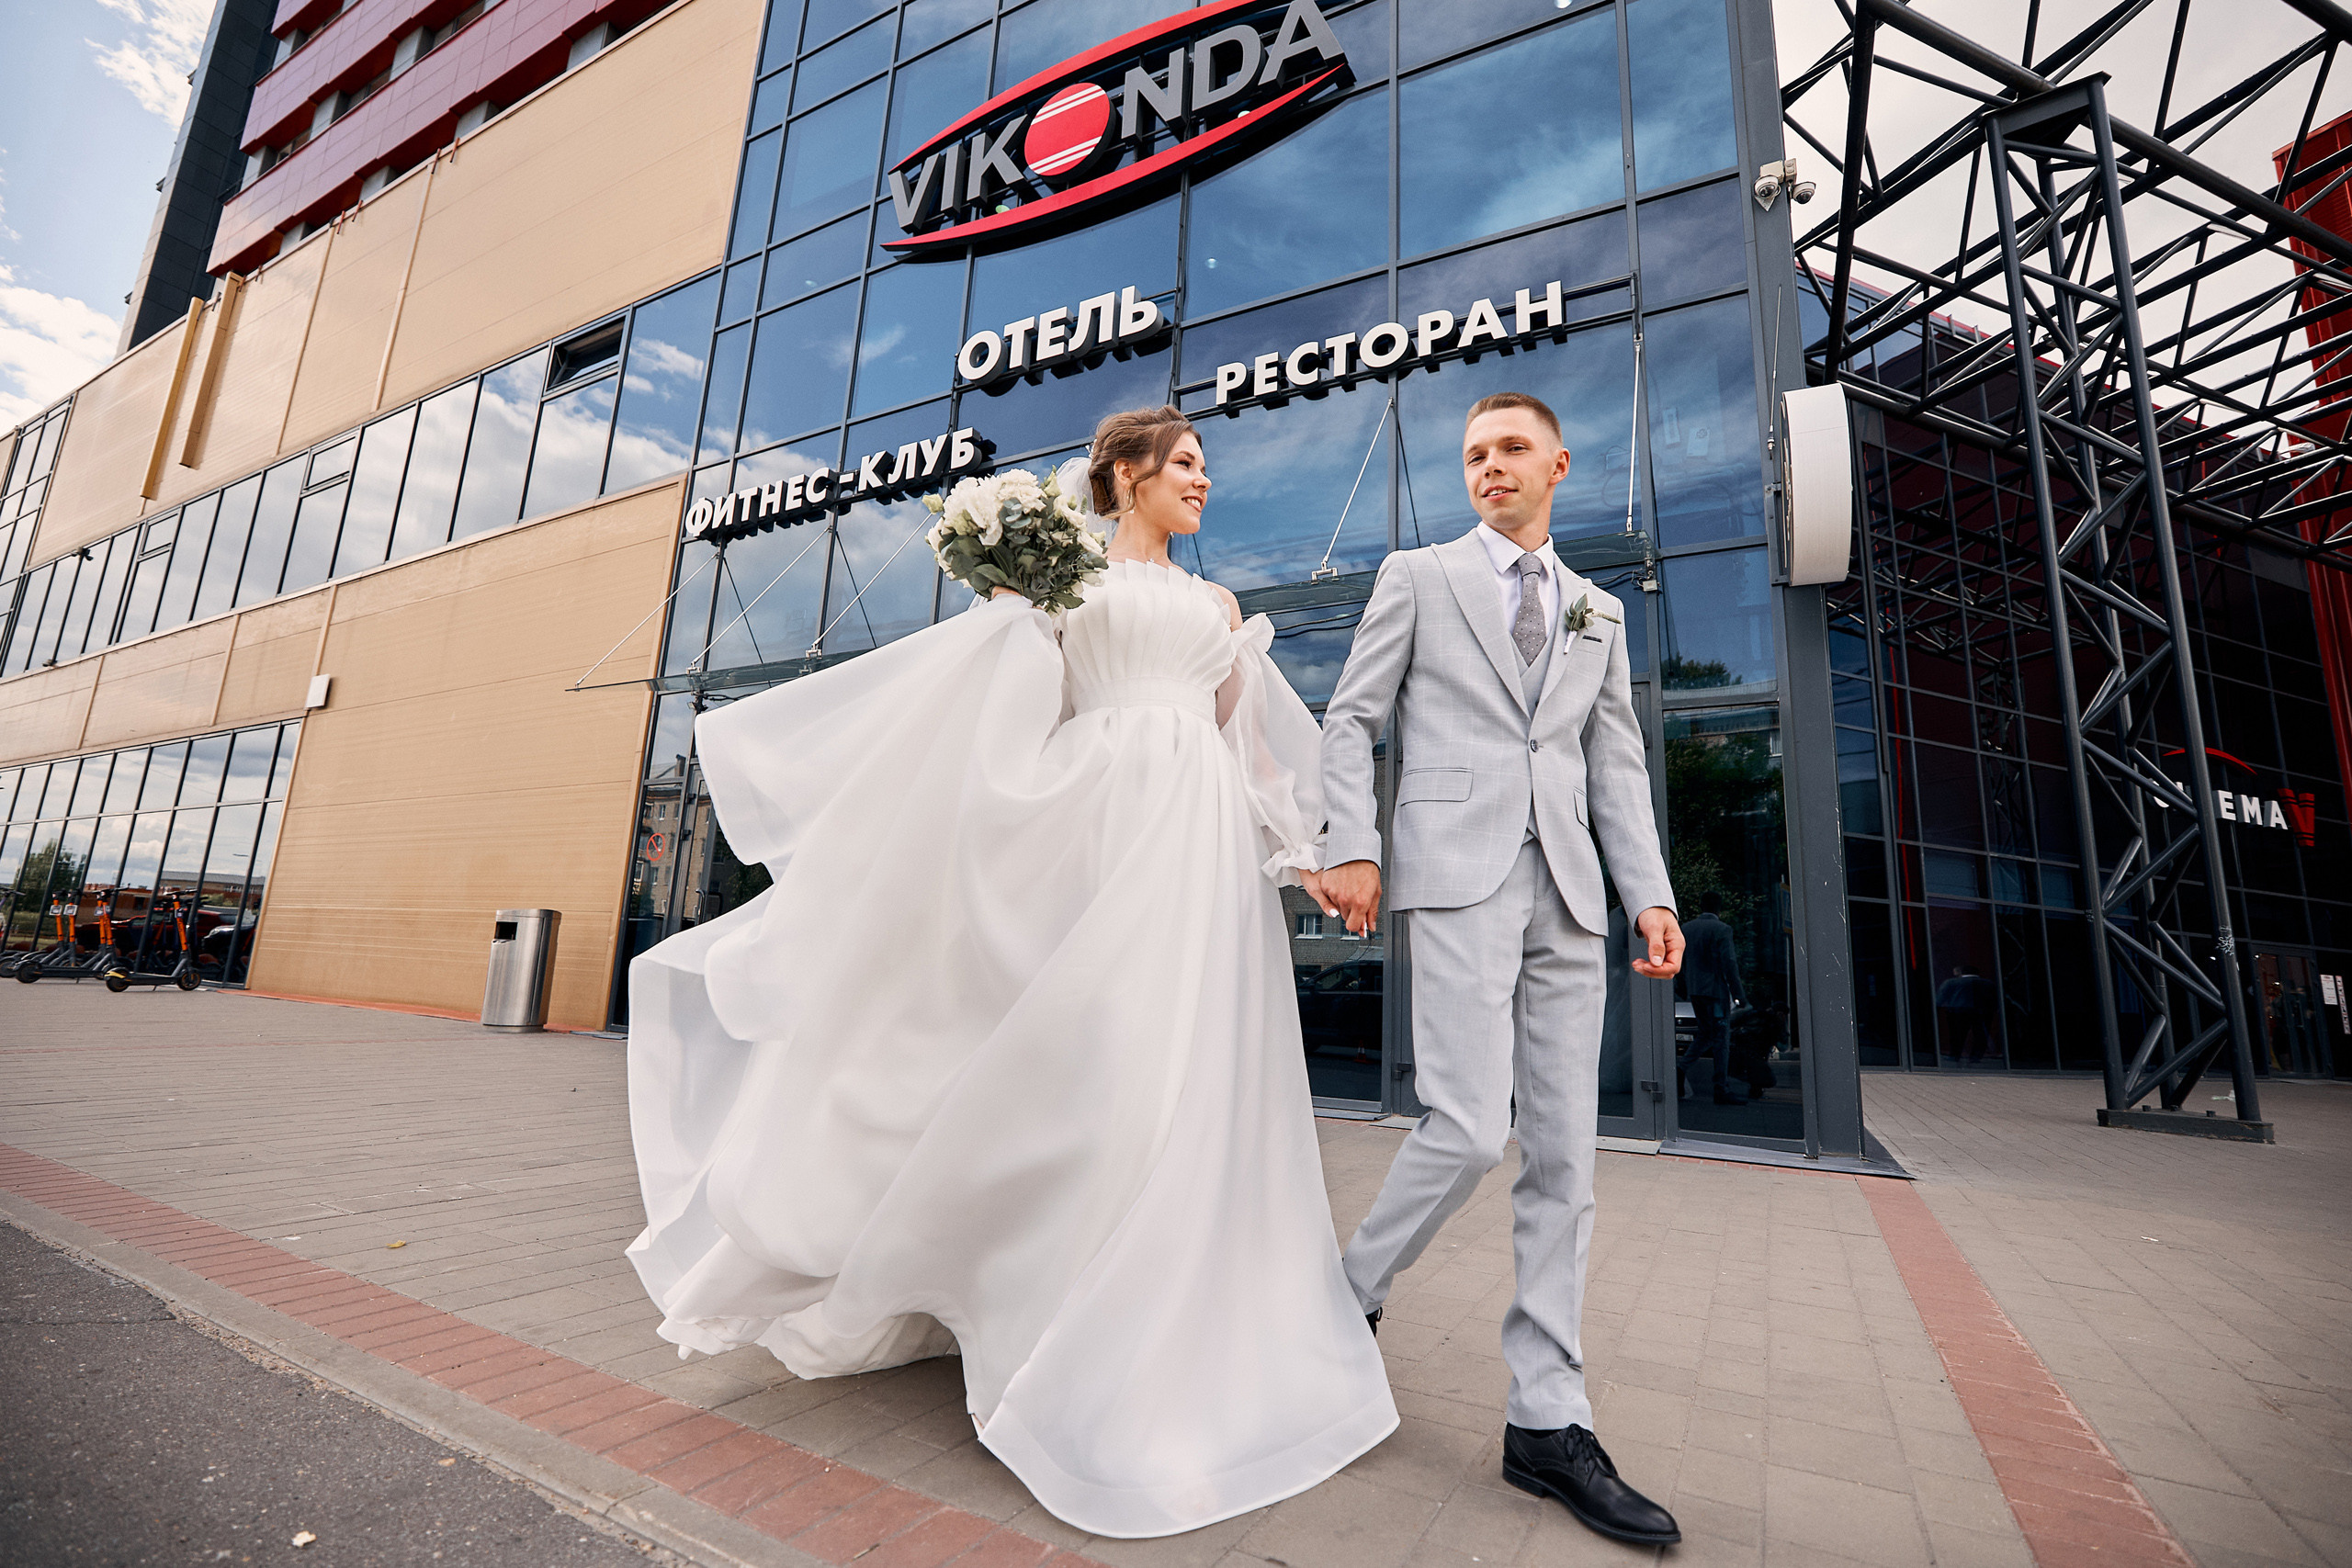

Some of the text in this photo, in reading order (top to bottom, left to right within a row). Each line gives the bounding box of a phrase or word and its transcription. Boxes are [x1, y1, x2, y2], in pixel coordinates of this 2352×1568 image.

[888, 0, 1345, 232] VIKONDA
[958, 285, 1159, 382] ОТЕЛЬ
[1215, 280, 1564, 406] РЕСТОРАН
[685, 427, 976, 536] ФИТНЕС-КЛУБ
